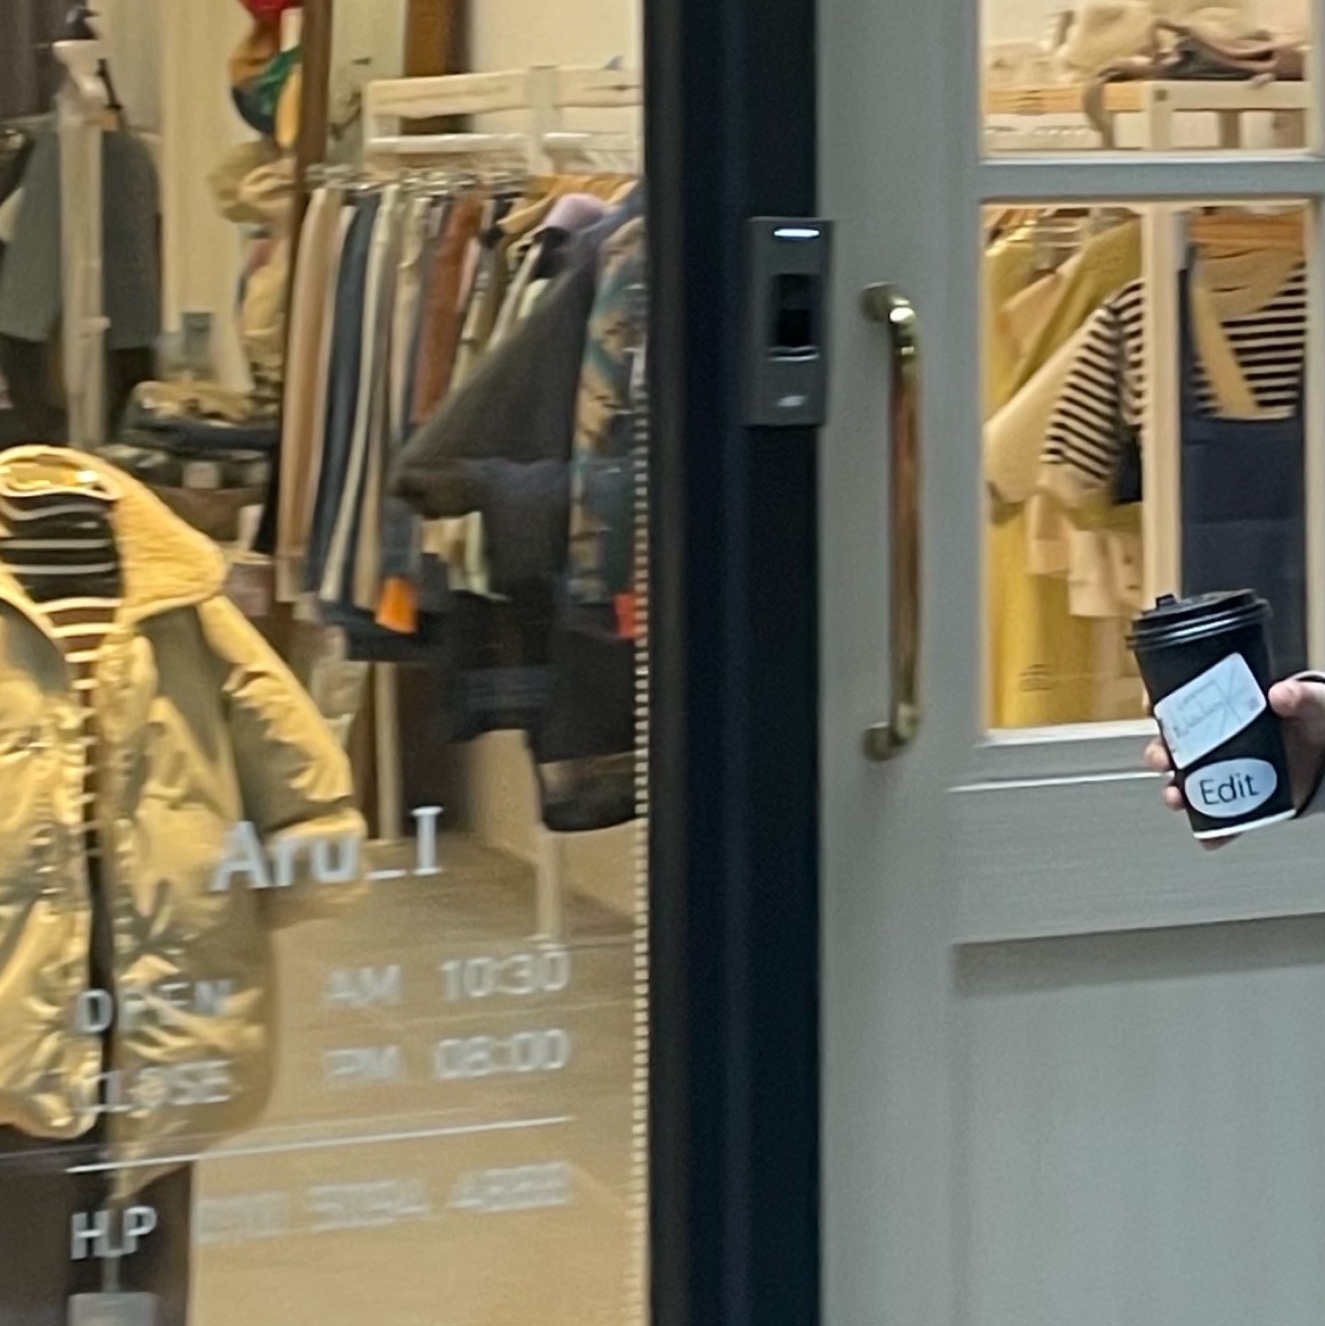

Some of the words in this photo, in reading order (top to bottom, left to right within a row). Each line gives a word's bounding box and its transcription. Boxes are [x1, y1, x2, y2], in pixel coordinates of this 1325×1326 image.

[1200, 771, 1260, 806] Edit
[208, 805, 444, 892] Aru_I
[75, 978, 232, 1034] OPEN
[325, 964, 401, 1005] AM
[438, 950, 570, 1002] 10:30
[325, 1045, 403, 1082] PM
